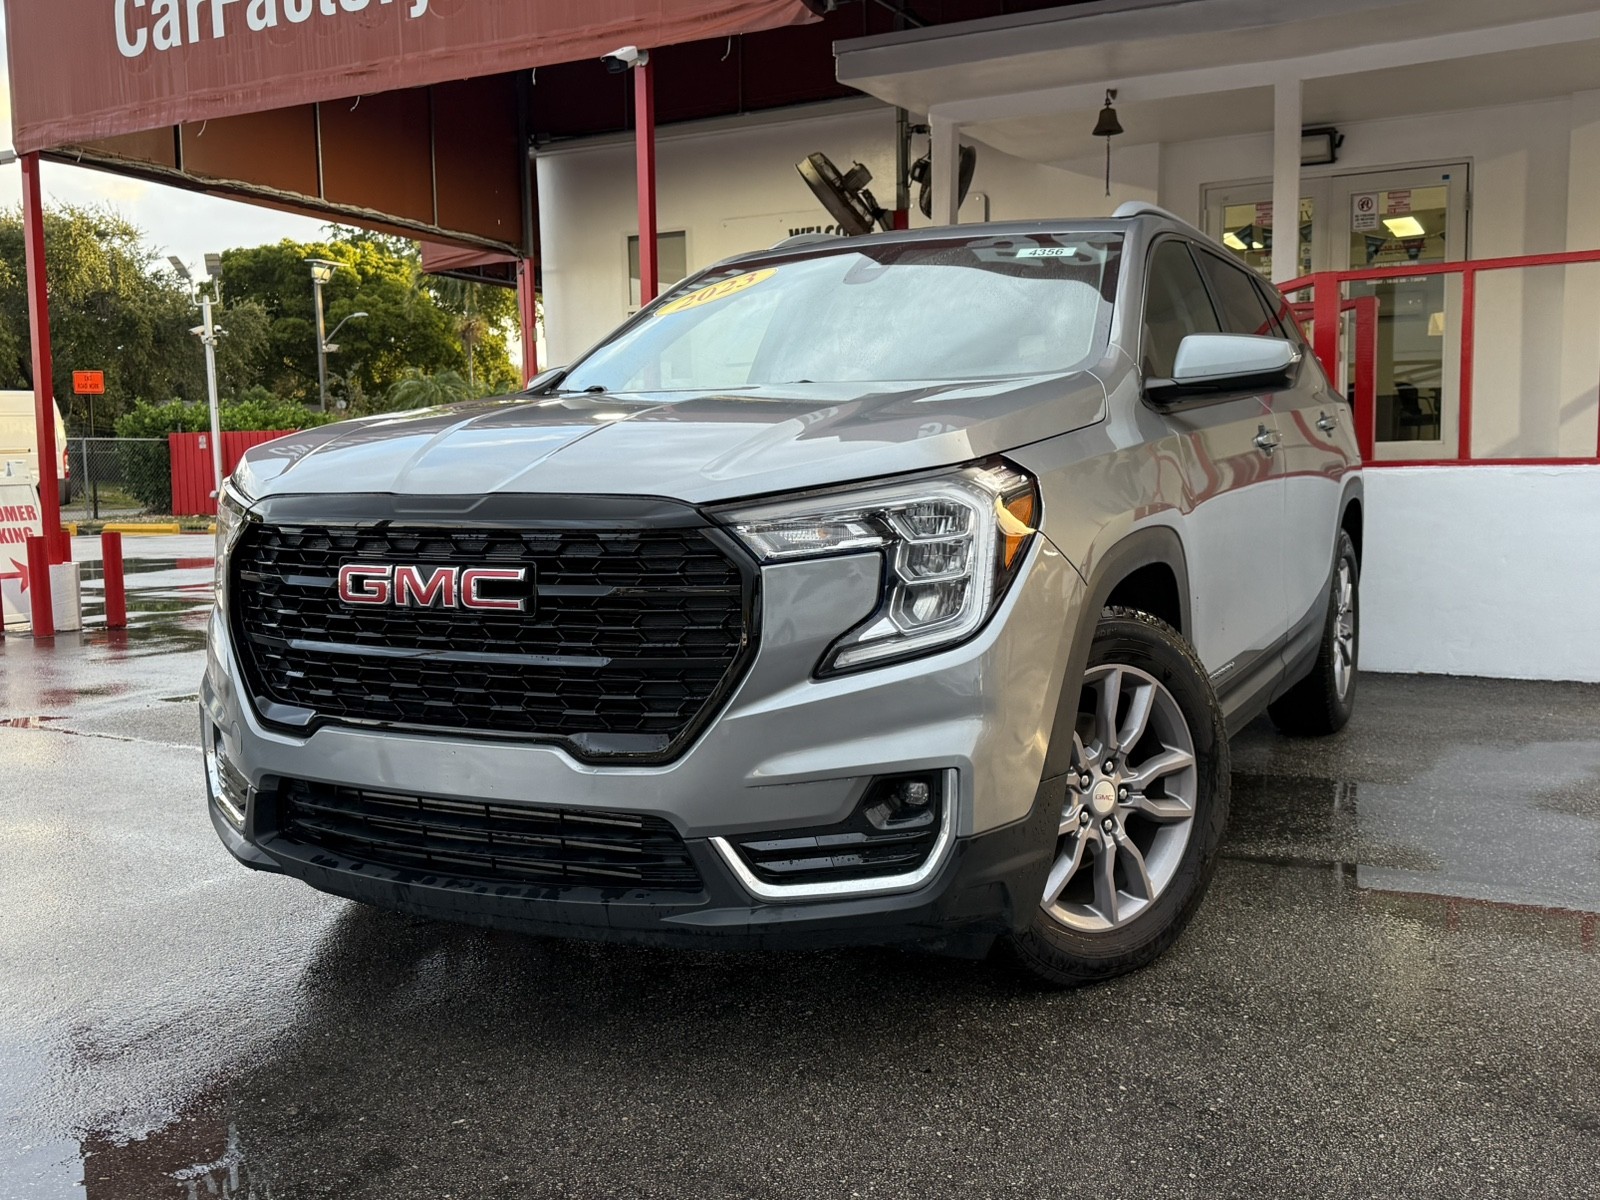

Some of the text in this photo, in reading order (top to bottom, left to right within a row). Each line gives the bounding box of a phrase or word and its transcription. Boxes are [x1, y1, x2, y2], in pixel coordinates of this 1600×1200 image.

[113, 0, 429, 58] CarFa
[1029, 248, 1064, 256] 4356
[674, 272, 757, 310] 2023
[337, 563, 528, 612] GMC
[1094, 793, 1114, 802] GMC
